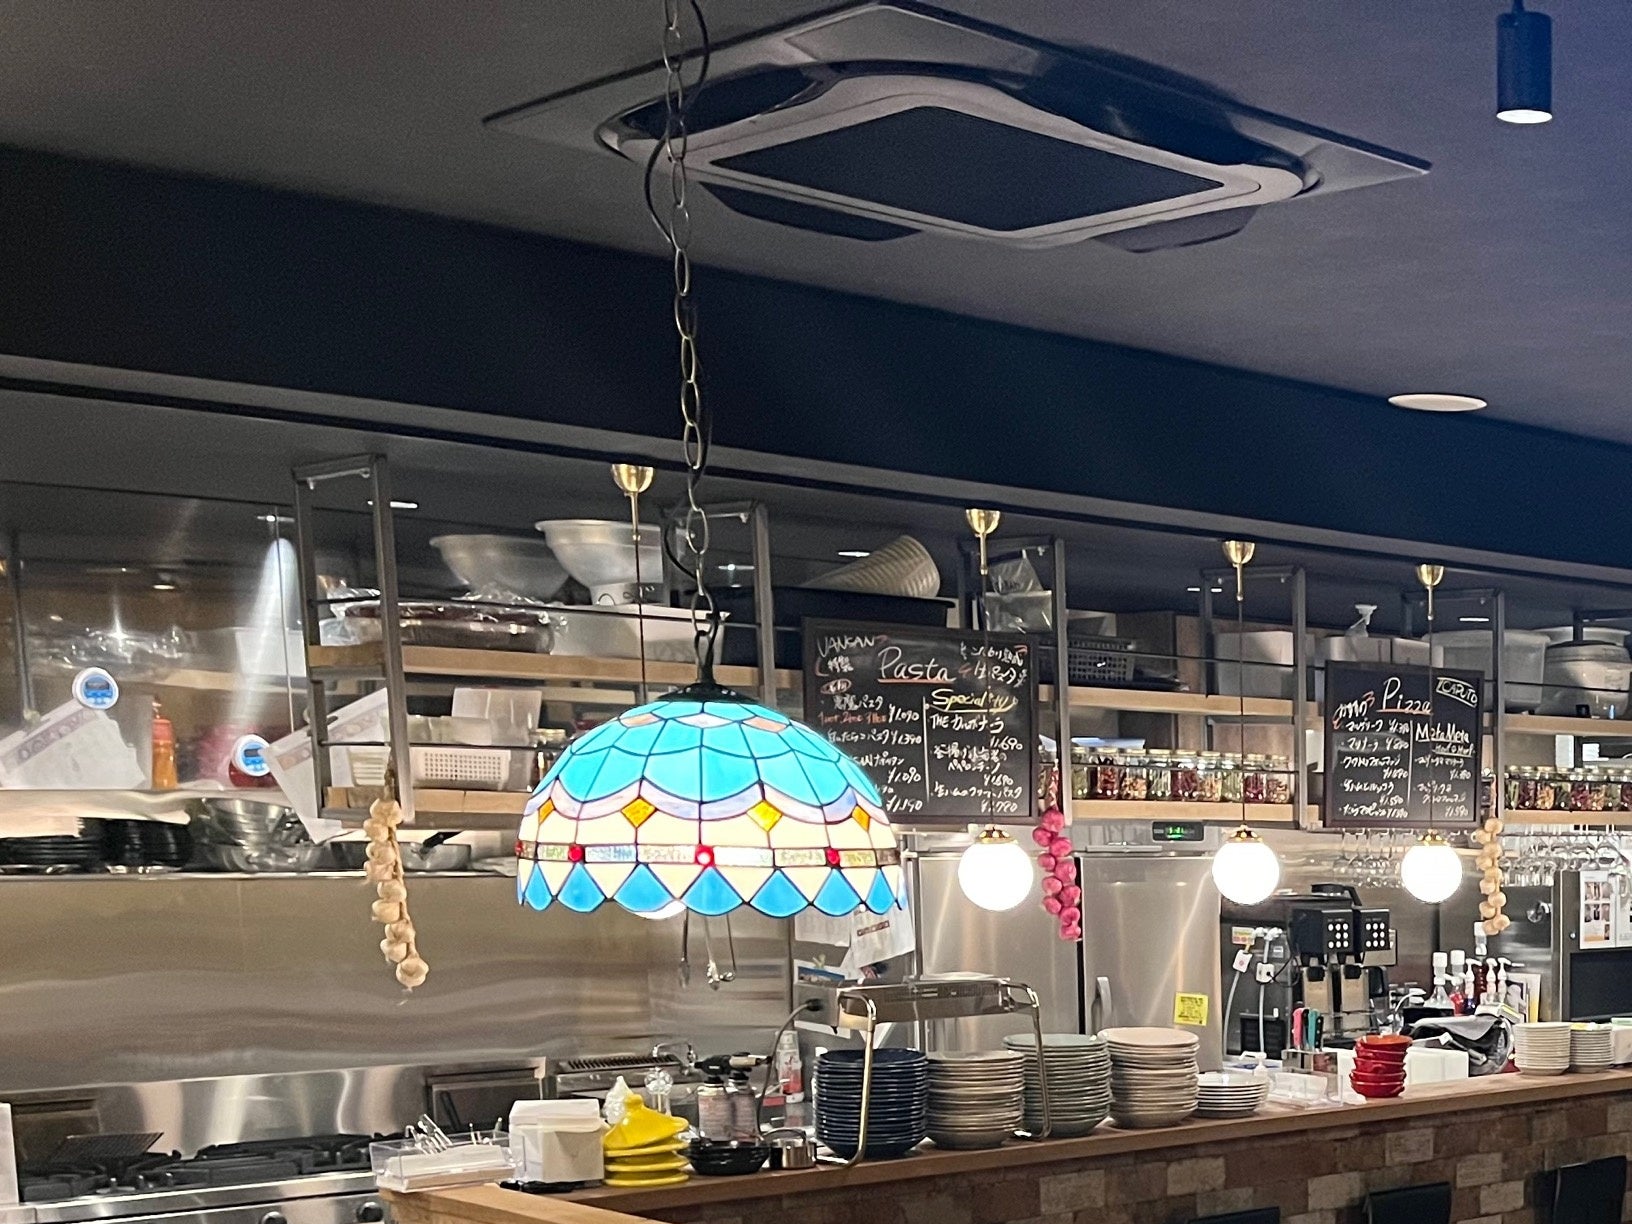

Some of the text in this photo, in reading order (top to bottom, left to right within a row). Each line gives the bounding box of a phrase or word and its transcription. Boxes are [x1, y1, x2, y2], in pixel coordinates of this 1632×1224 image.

[877, 645, 956, 682] Pasta
[1382, 677, 1431, 713] Pizza
[930, 714, 949, 730] THE
